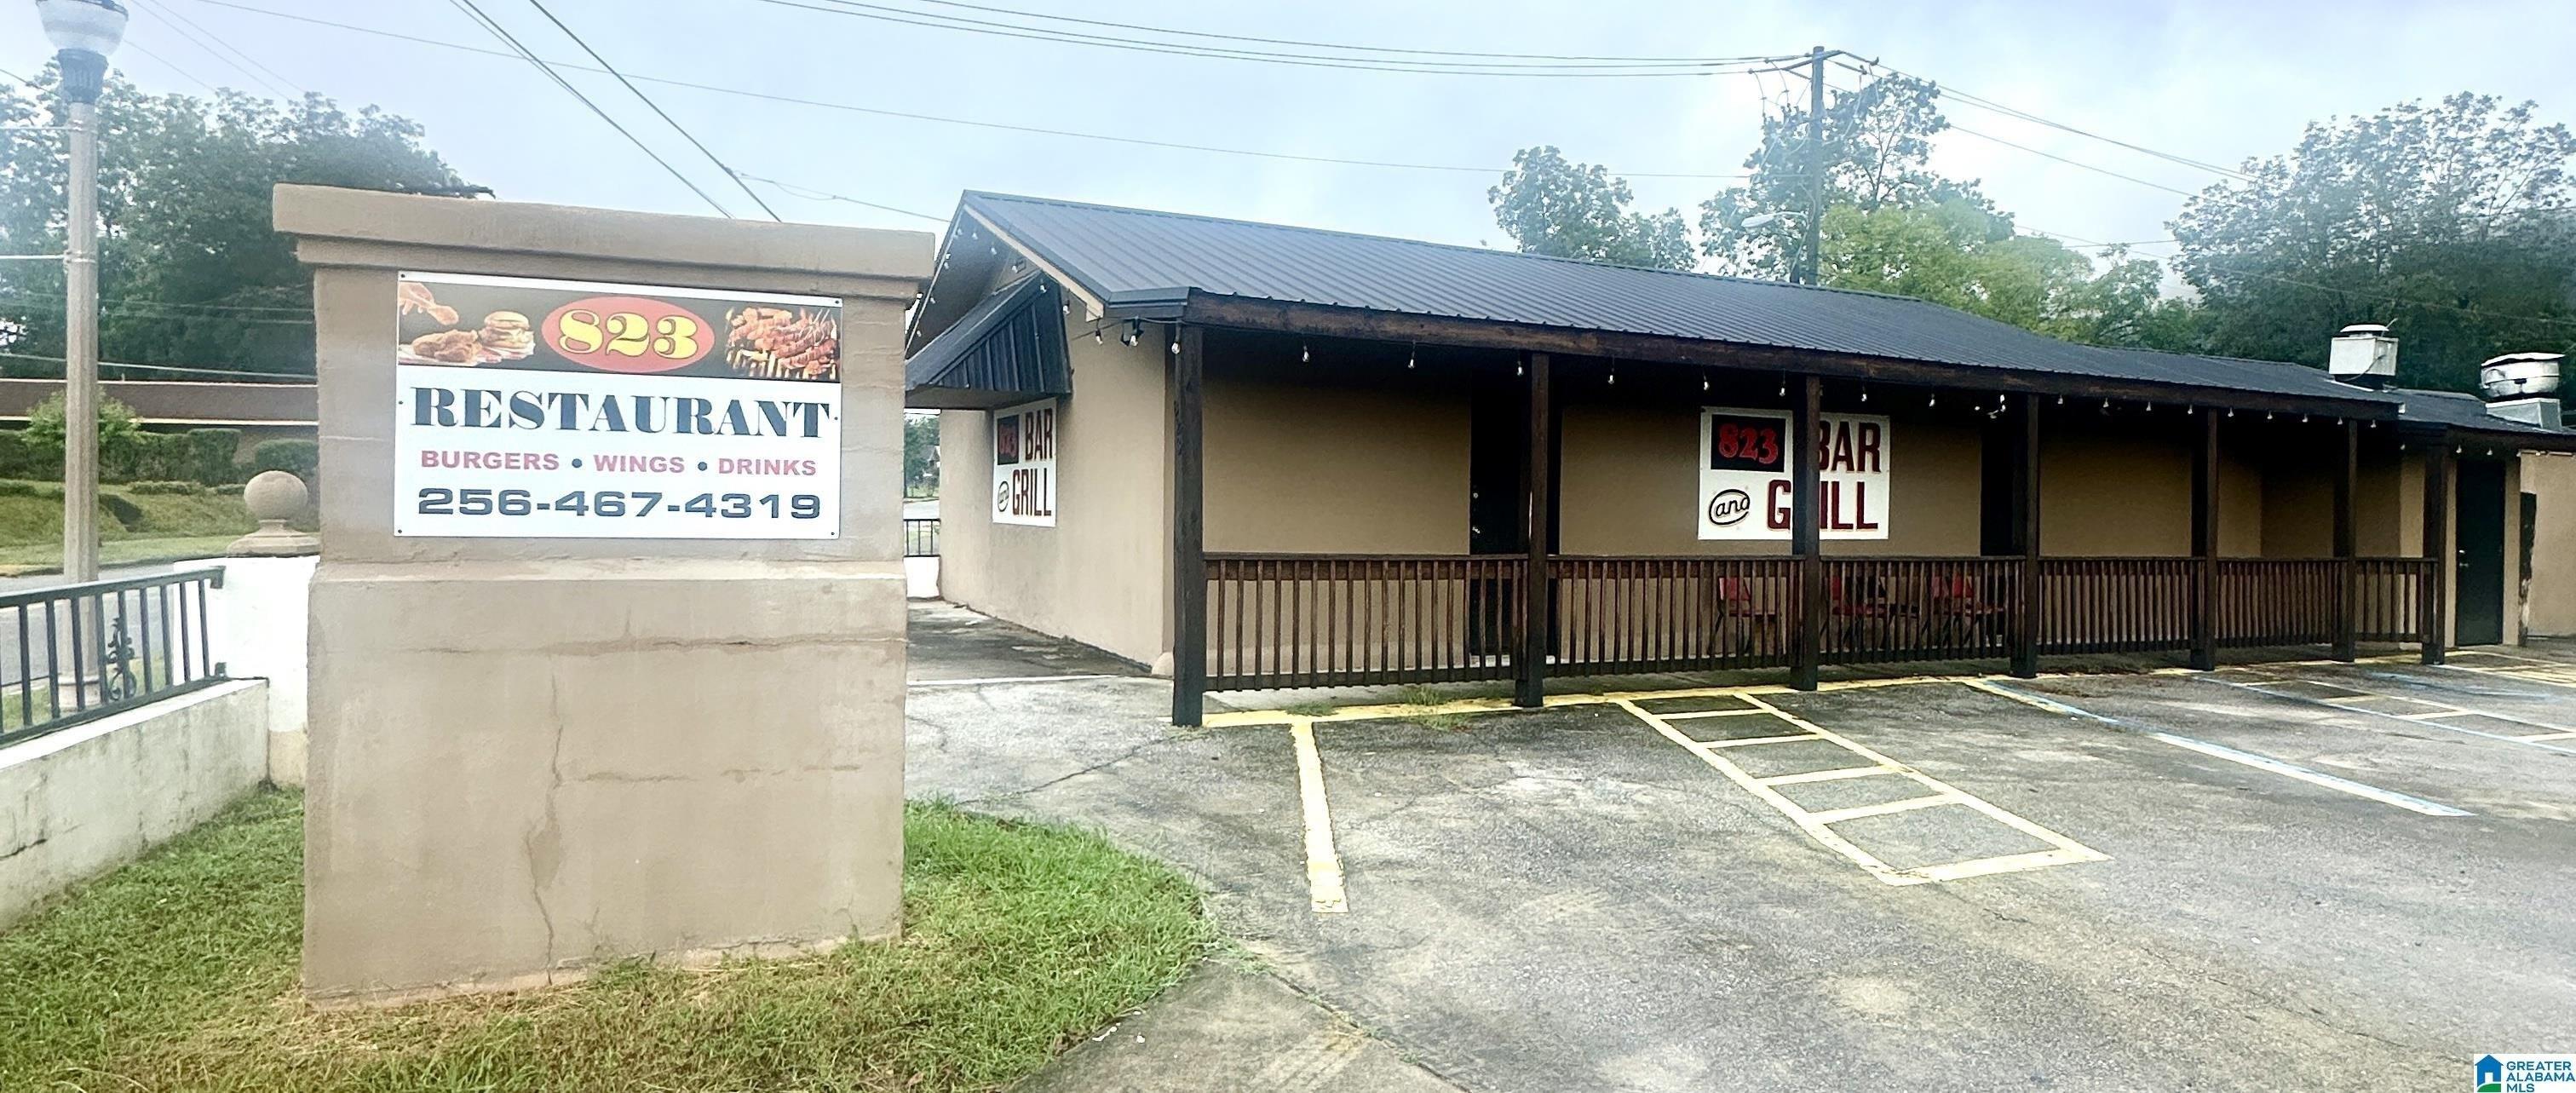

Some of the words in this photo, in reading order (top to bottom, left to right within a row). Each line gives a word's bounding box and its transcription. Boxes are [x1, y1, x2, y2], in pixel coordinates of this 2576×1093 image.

[559, 308, 699, 360] 823
[410, 386, 831, 439] RESTAURANT
[1025, 407, 1053, 461] BAR
[420, 450, 560, 472] BURGERS
[593, 454, 686, 474] WINGS
[718, 457, 817, 476] DRINKS
[1718, 423, 1779, 464] 823
[417, 488, 820, 520] 256-467-4319
[1012, 468, 1052, 516] GRILL
[1714, 493, 1750, 518] and
[1768, 480, 1878, 530] GILL
